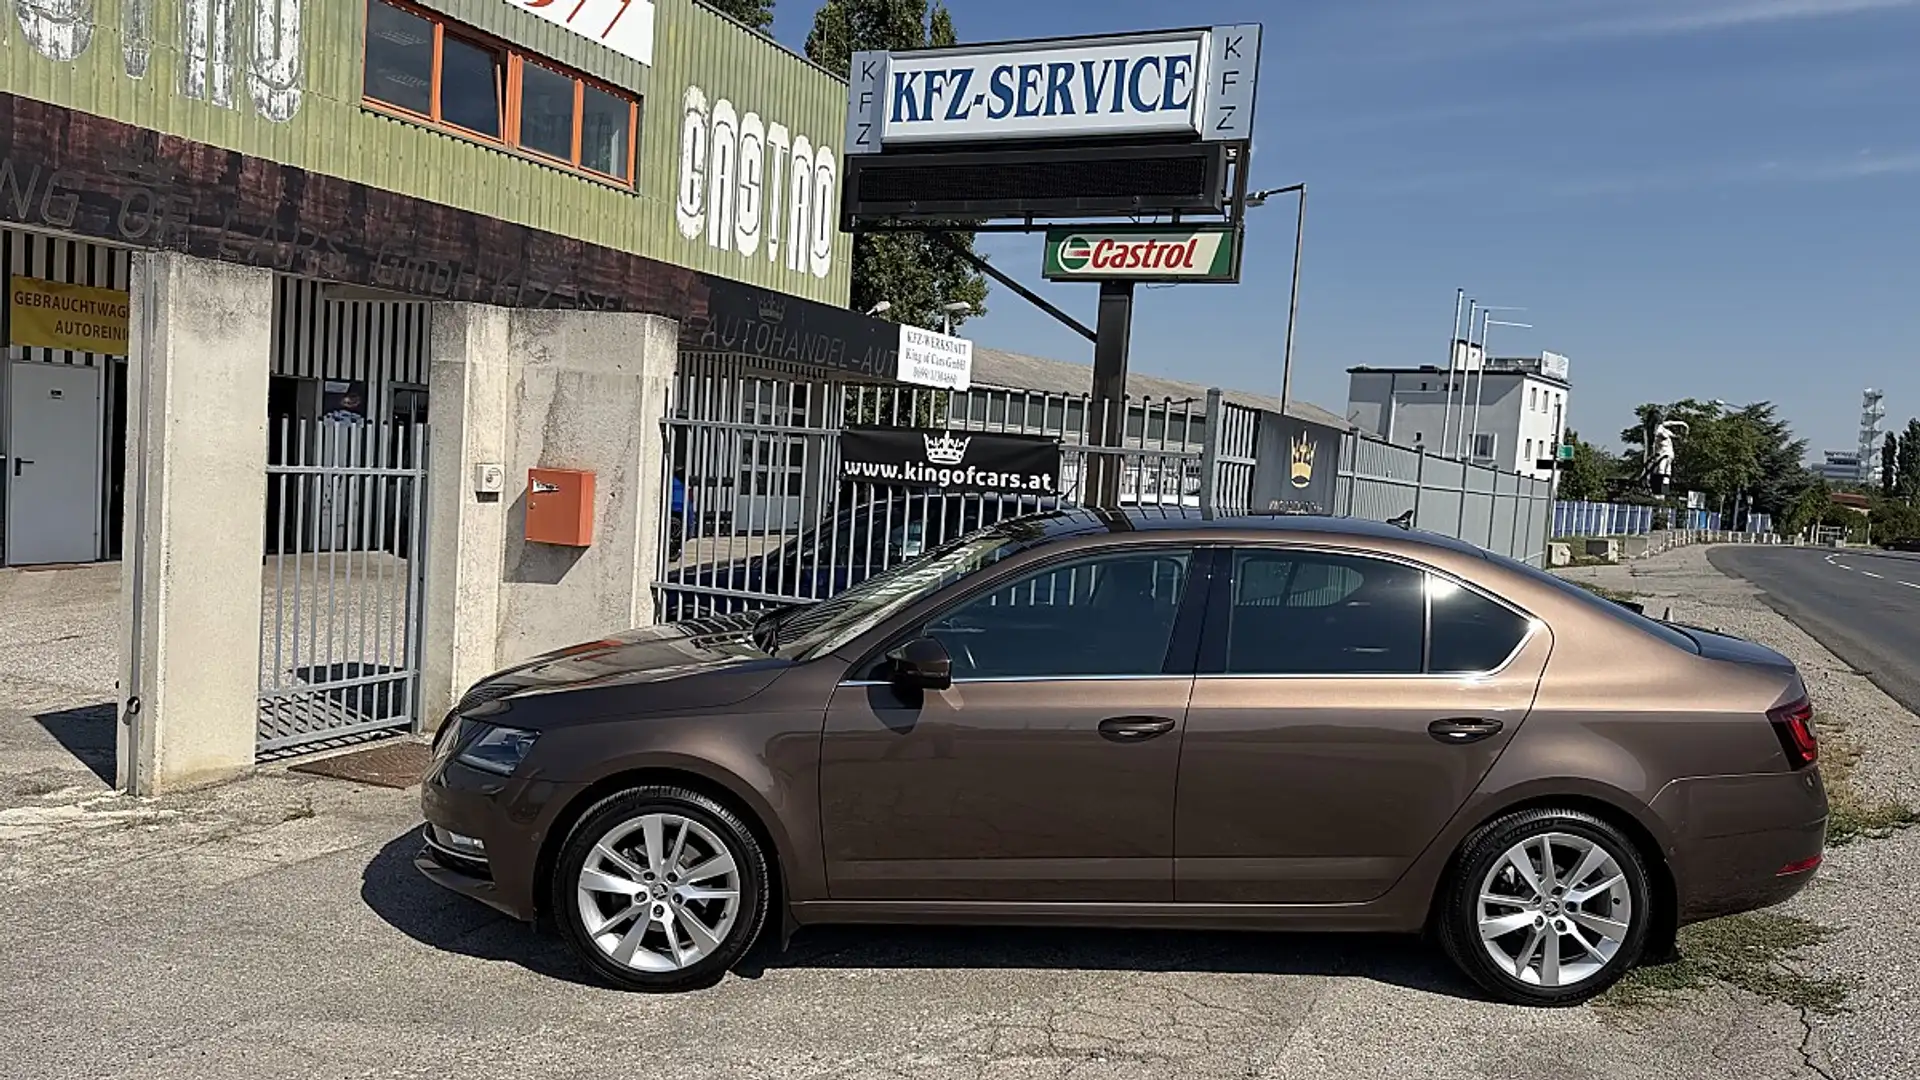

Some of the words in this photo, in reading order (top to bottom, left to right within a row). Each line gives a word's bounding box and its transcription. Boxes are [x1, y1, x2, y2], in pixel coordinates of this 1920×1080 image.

[889, 54, 1195, 124] KFZ-SERVICE
[1216, 35, 1243, 131] KFZ
[856, 60, 877, 146] KFZ
[1092, 238, 1198, 269] Castrol
[14, 291, 129, 319] GEBRAUCHTWAG
[55, 320, 128, 341] AUTOREINI
[844, 461, 1052, 490] www.kingofcars.at
